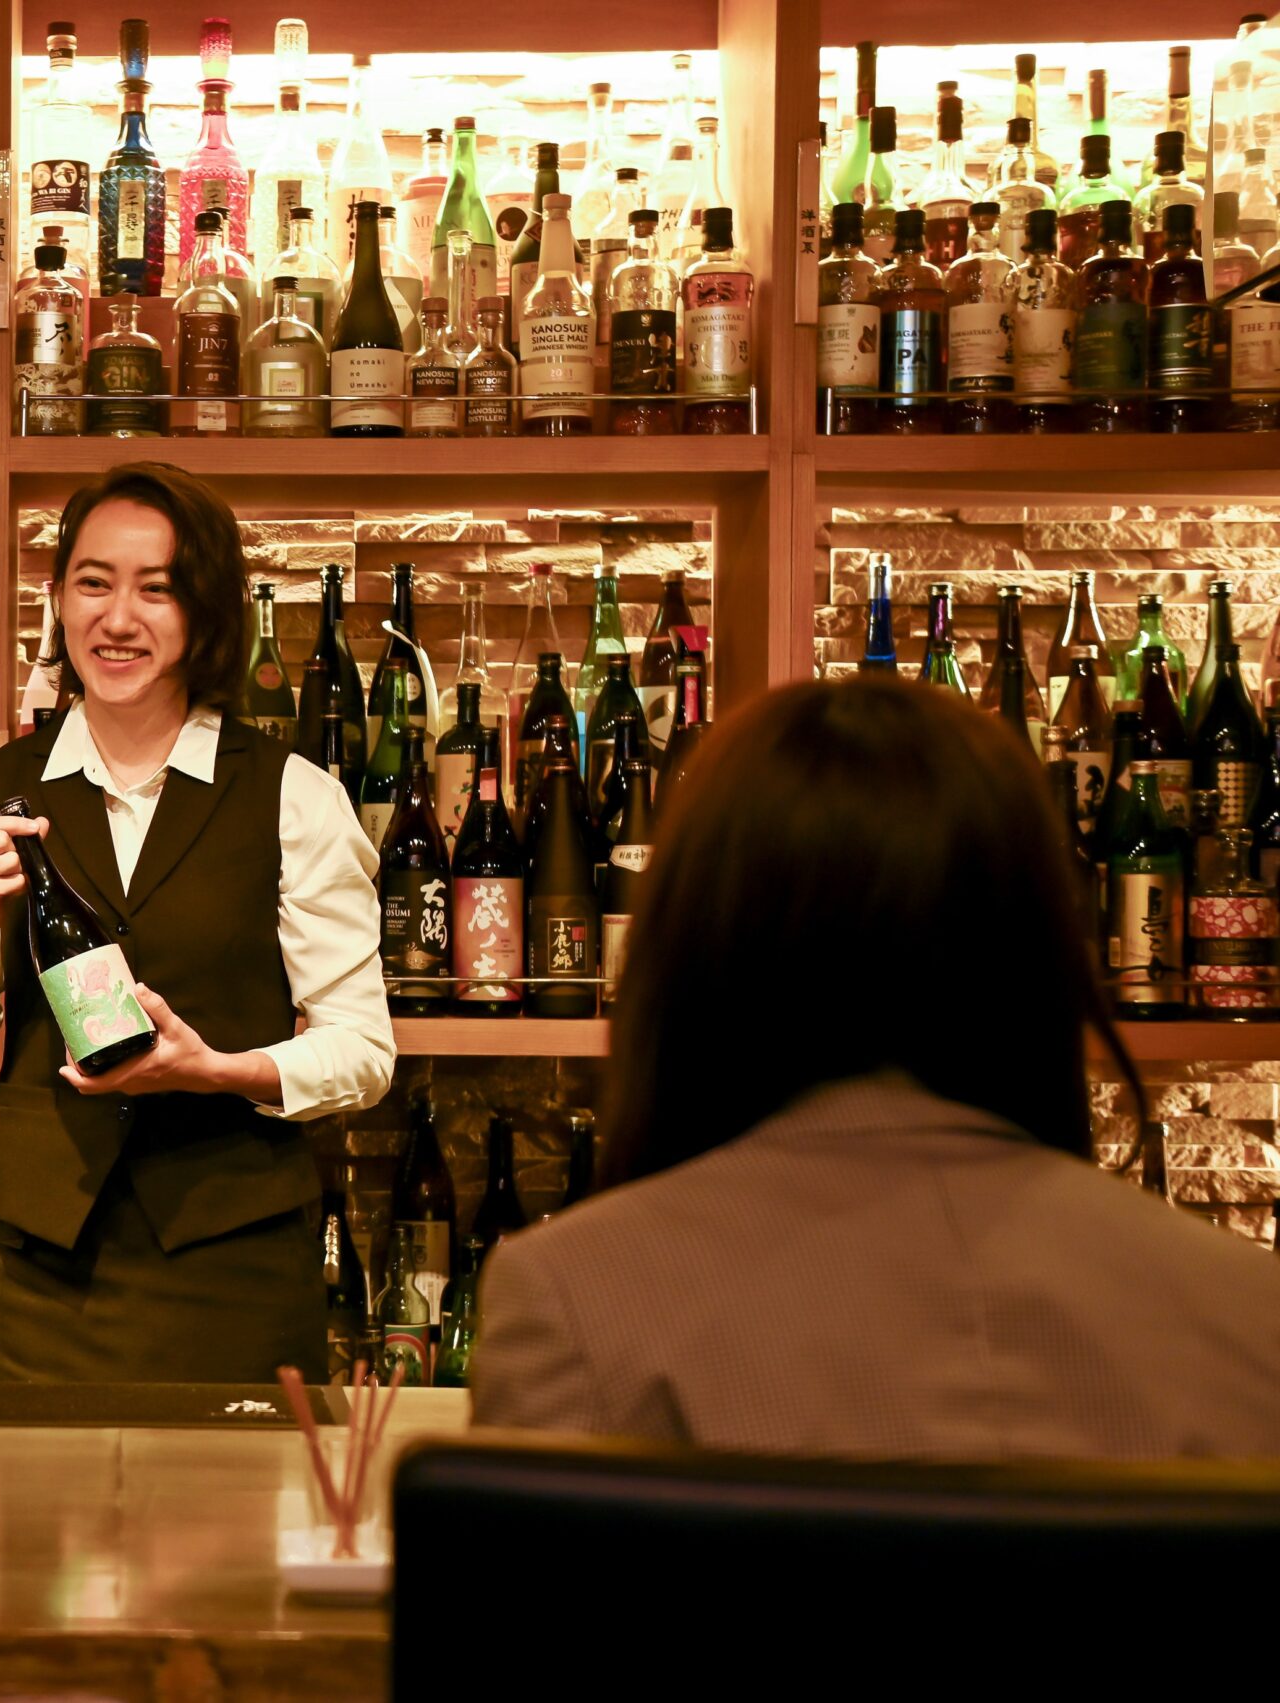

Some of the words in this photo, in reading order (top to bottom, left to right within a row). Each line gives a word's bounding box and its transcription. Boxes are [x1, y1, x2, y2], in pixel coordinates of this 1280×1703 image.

[531, 323, 588, 335] KANOSUKE
[531, 336, 563, 345] SINGLE
[566, 335, 588, 344] MALT
[386, 909, 411, 917] OSUMI
